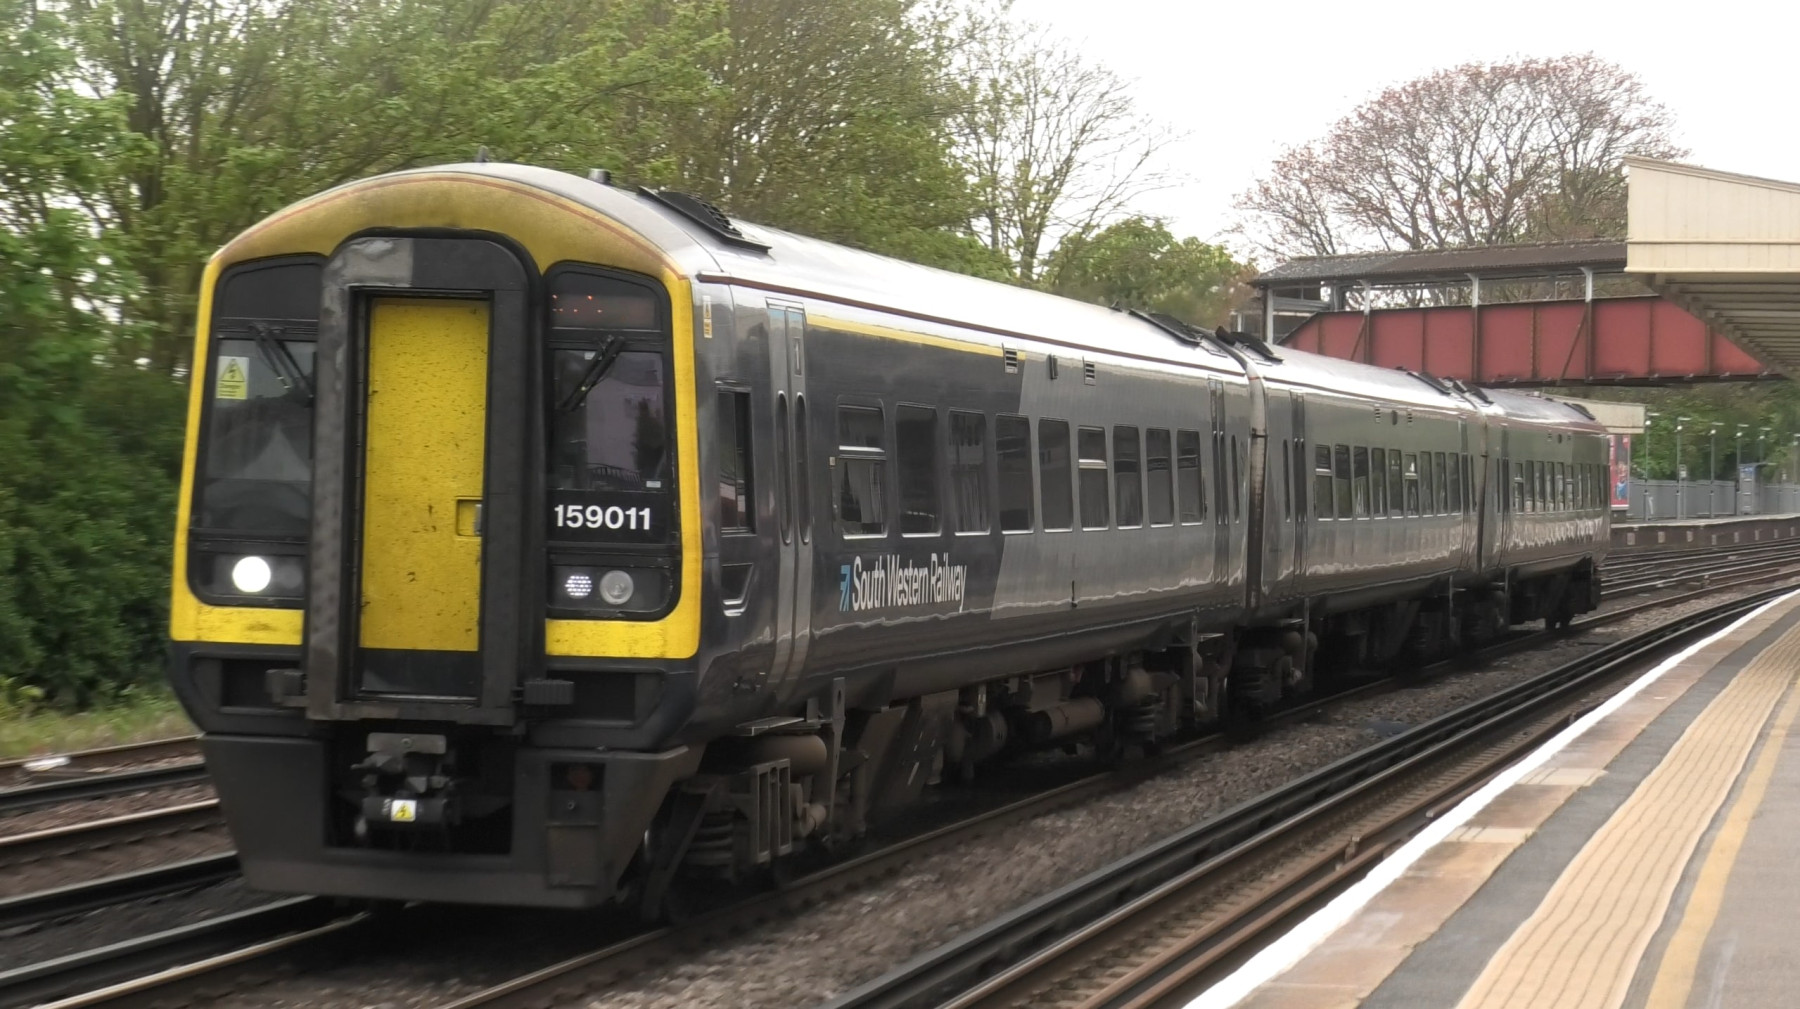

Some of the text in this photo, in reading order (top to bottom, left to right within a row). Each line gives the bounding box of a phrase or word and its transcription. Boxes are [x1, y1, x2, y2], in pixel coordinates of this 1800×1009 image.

[554, 504, 650, 530] 159011
[852, 552, 967, 613] South Western Railway
